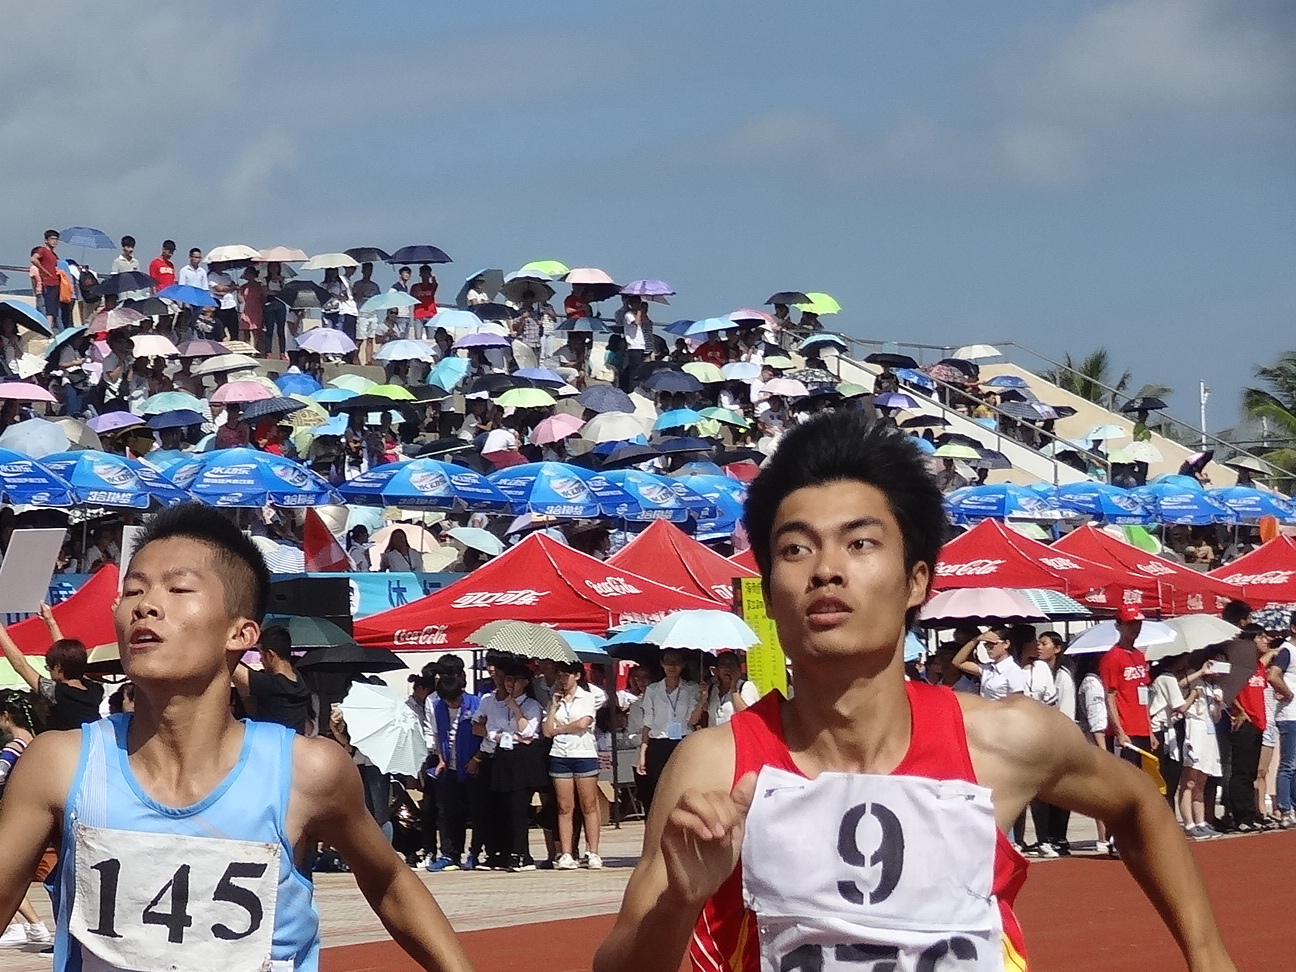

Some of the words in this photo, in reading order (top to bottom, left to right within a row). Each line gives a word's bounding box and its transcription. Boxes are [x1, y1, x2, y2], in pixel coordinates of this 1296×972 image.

[210, 466, 251, 475] 水动乐
[450, 589, 552, 608] 可口可乐
[837, 802, 905, 905] 9
[87, 858, 268, 944] 145
